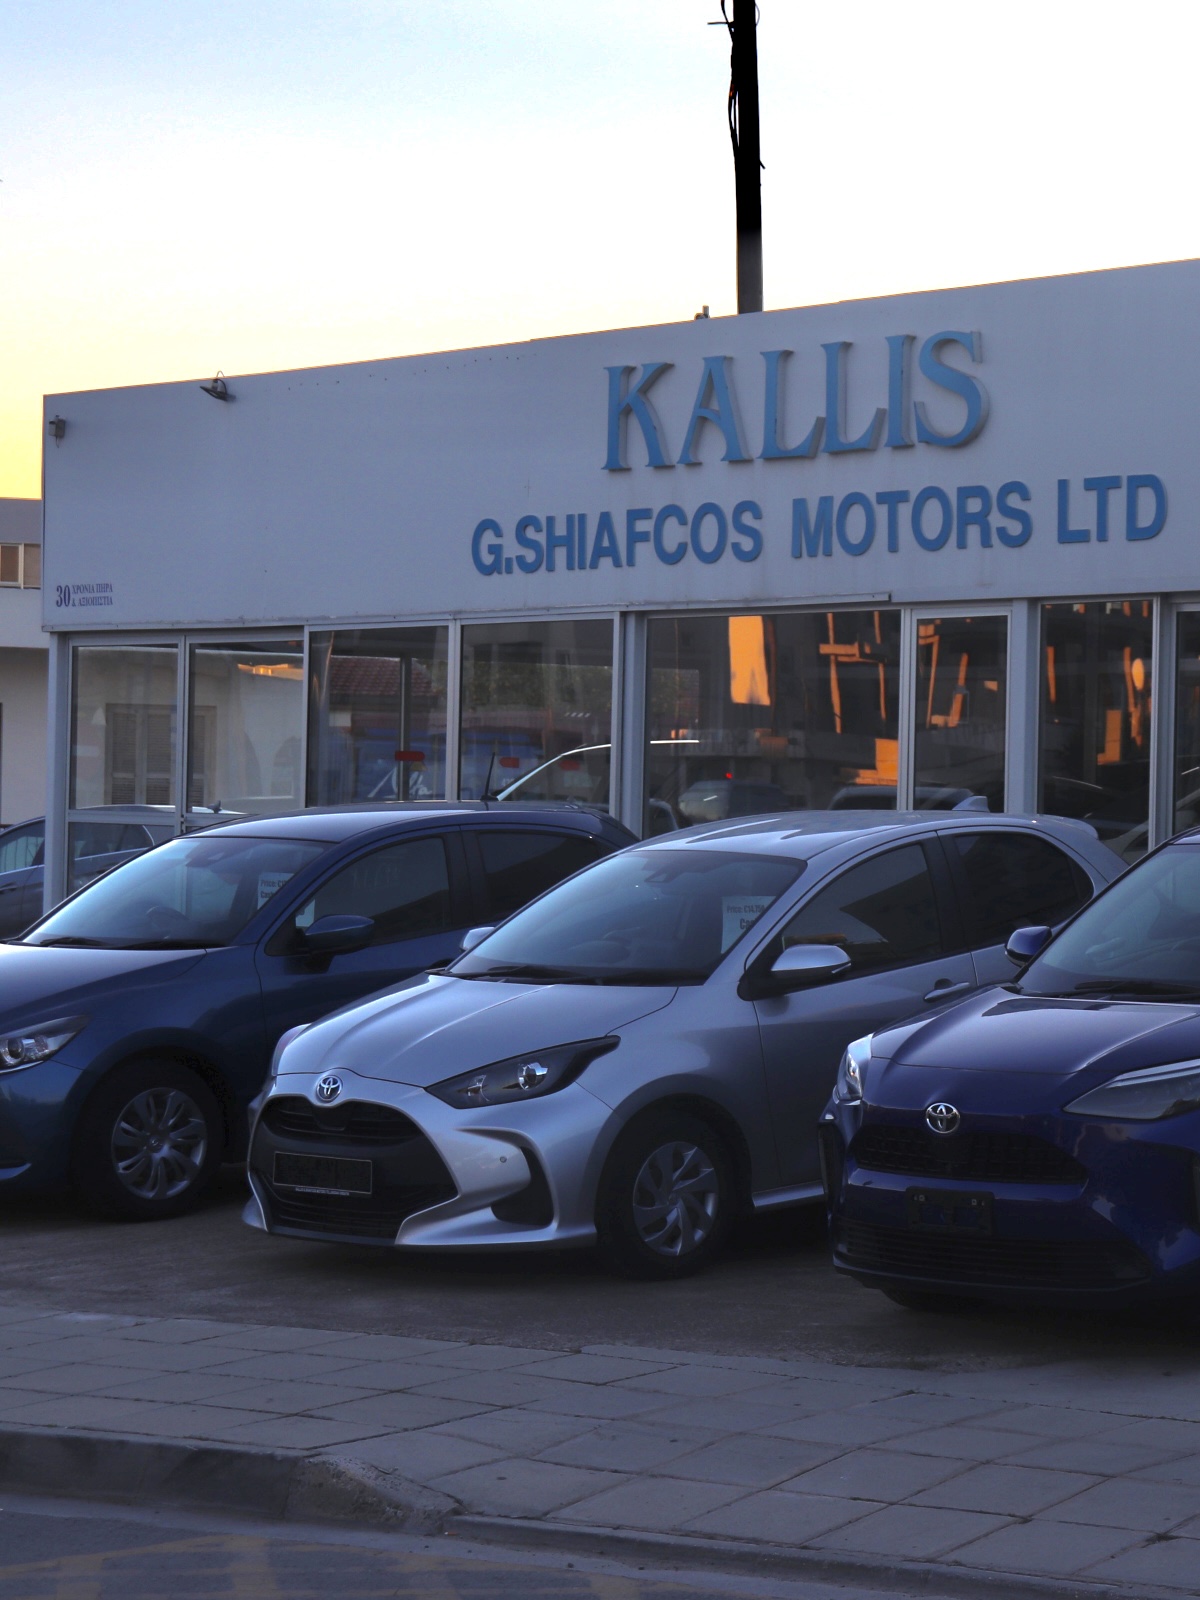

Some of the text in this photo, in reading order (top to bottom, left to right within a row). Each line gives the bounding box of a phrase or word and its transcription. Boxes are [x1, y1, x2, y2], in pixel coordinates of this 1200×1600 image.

[601, 330, 991, 471] KALLIS
[471, 473, 1168, 576] G.SHIAFCOS MOTORS LTD
[56, 584, 71, 607] 30
